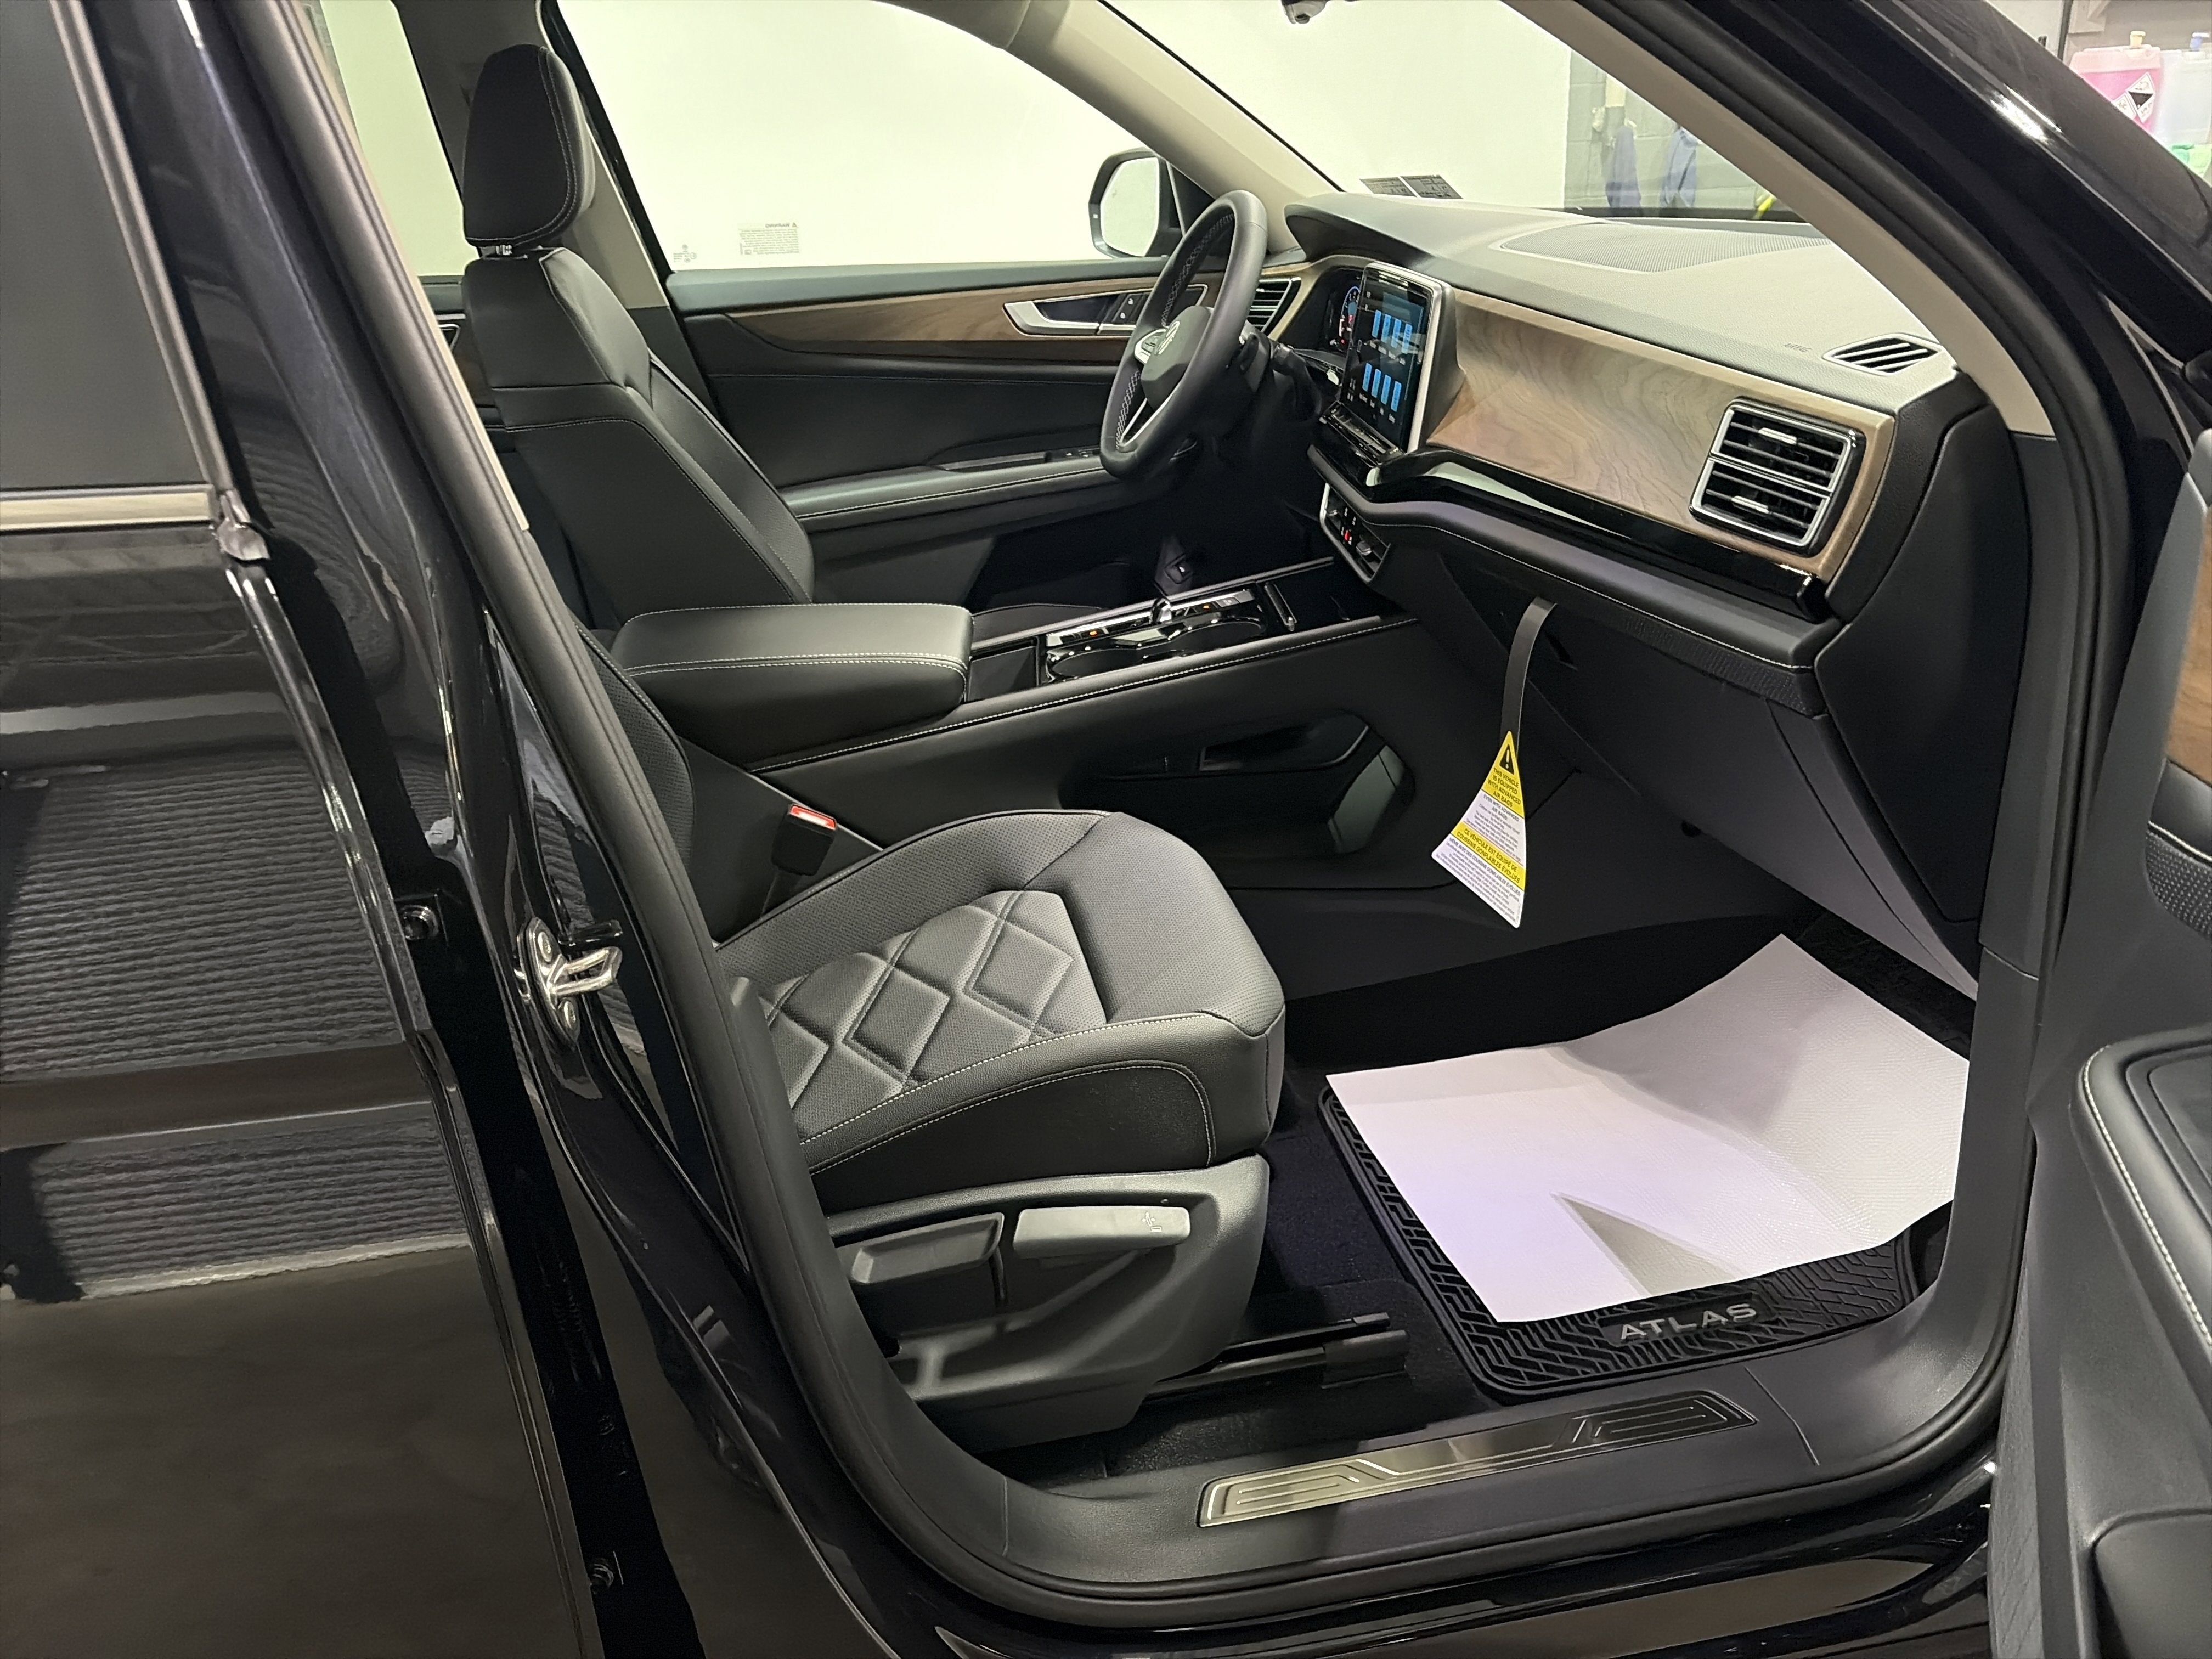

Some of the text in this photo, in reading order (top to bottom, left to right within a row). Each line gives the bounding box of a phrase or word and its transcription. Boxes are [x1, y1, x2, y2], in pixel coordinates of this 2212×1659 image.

[1493, 767, 1519, 788] THIS VEHICLE
[1497, 777, 1518, 795] EQUIPPED
[1487, 779, 1521, 805] WITH ADVANCED
[1500, 795, 1513, 808] BAGS
[1457, 831, 1476, 849] COUSSINS
[1476, 847, 1502, 870] GONFLABLES
[1488, 846, 1497, 855] EST
[1510, 864, 1517, 873] DE
[1621, 1303, 1757, 1340] ATLAS
